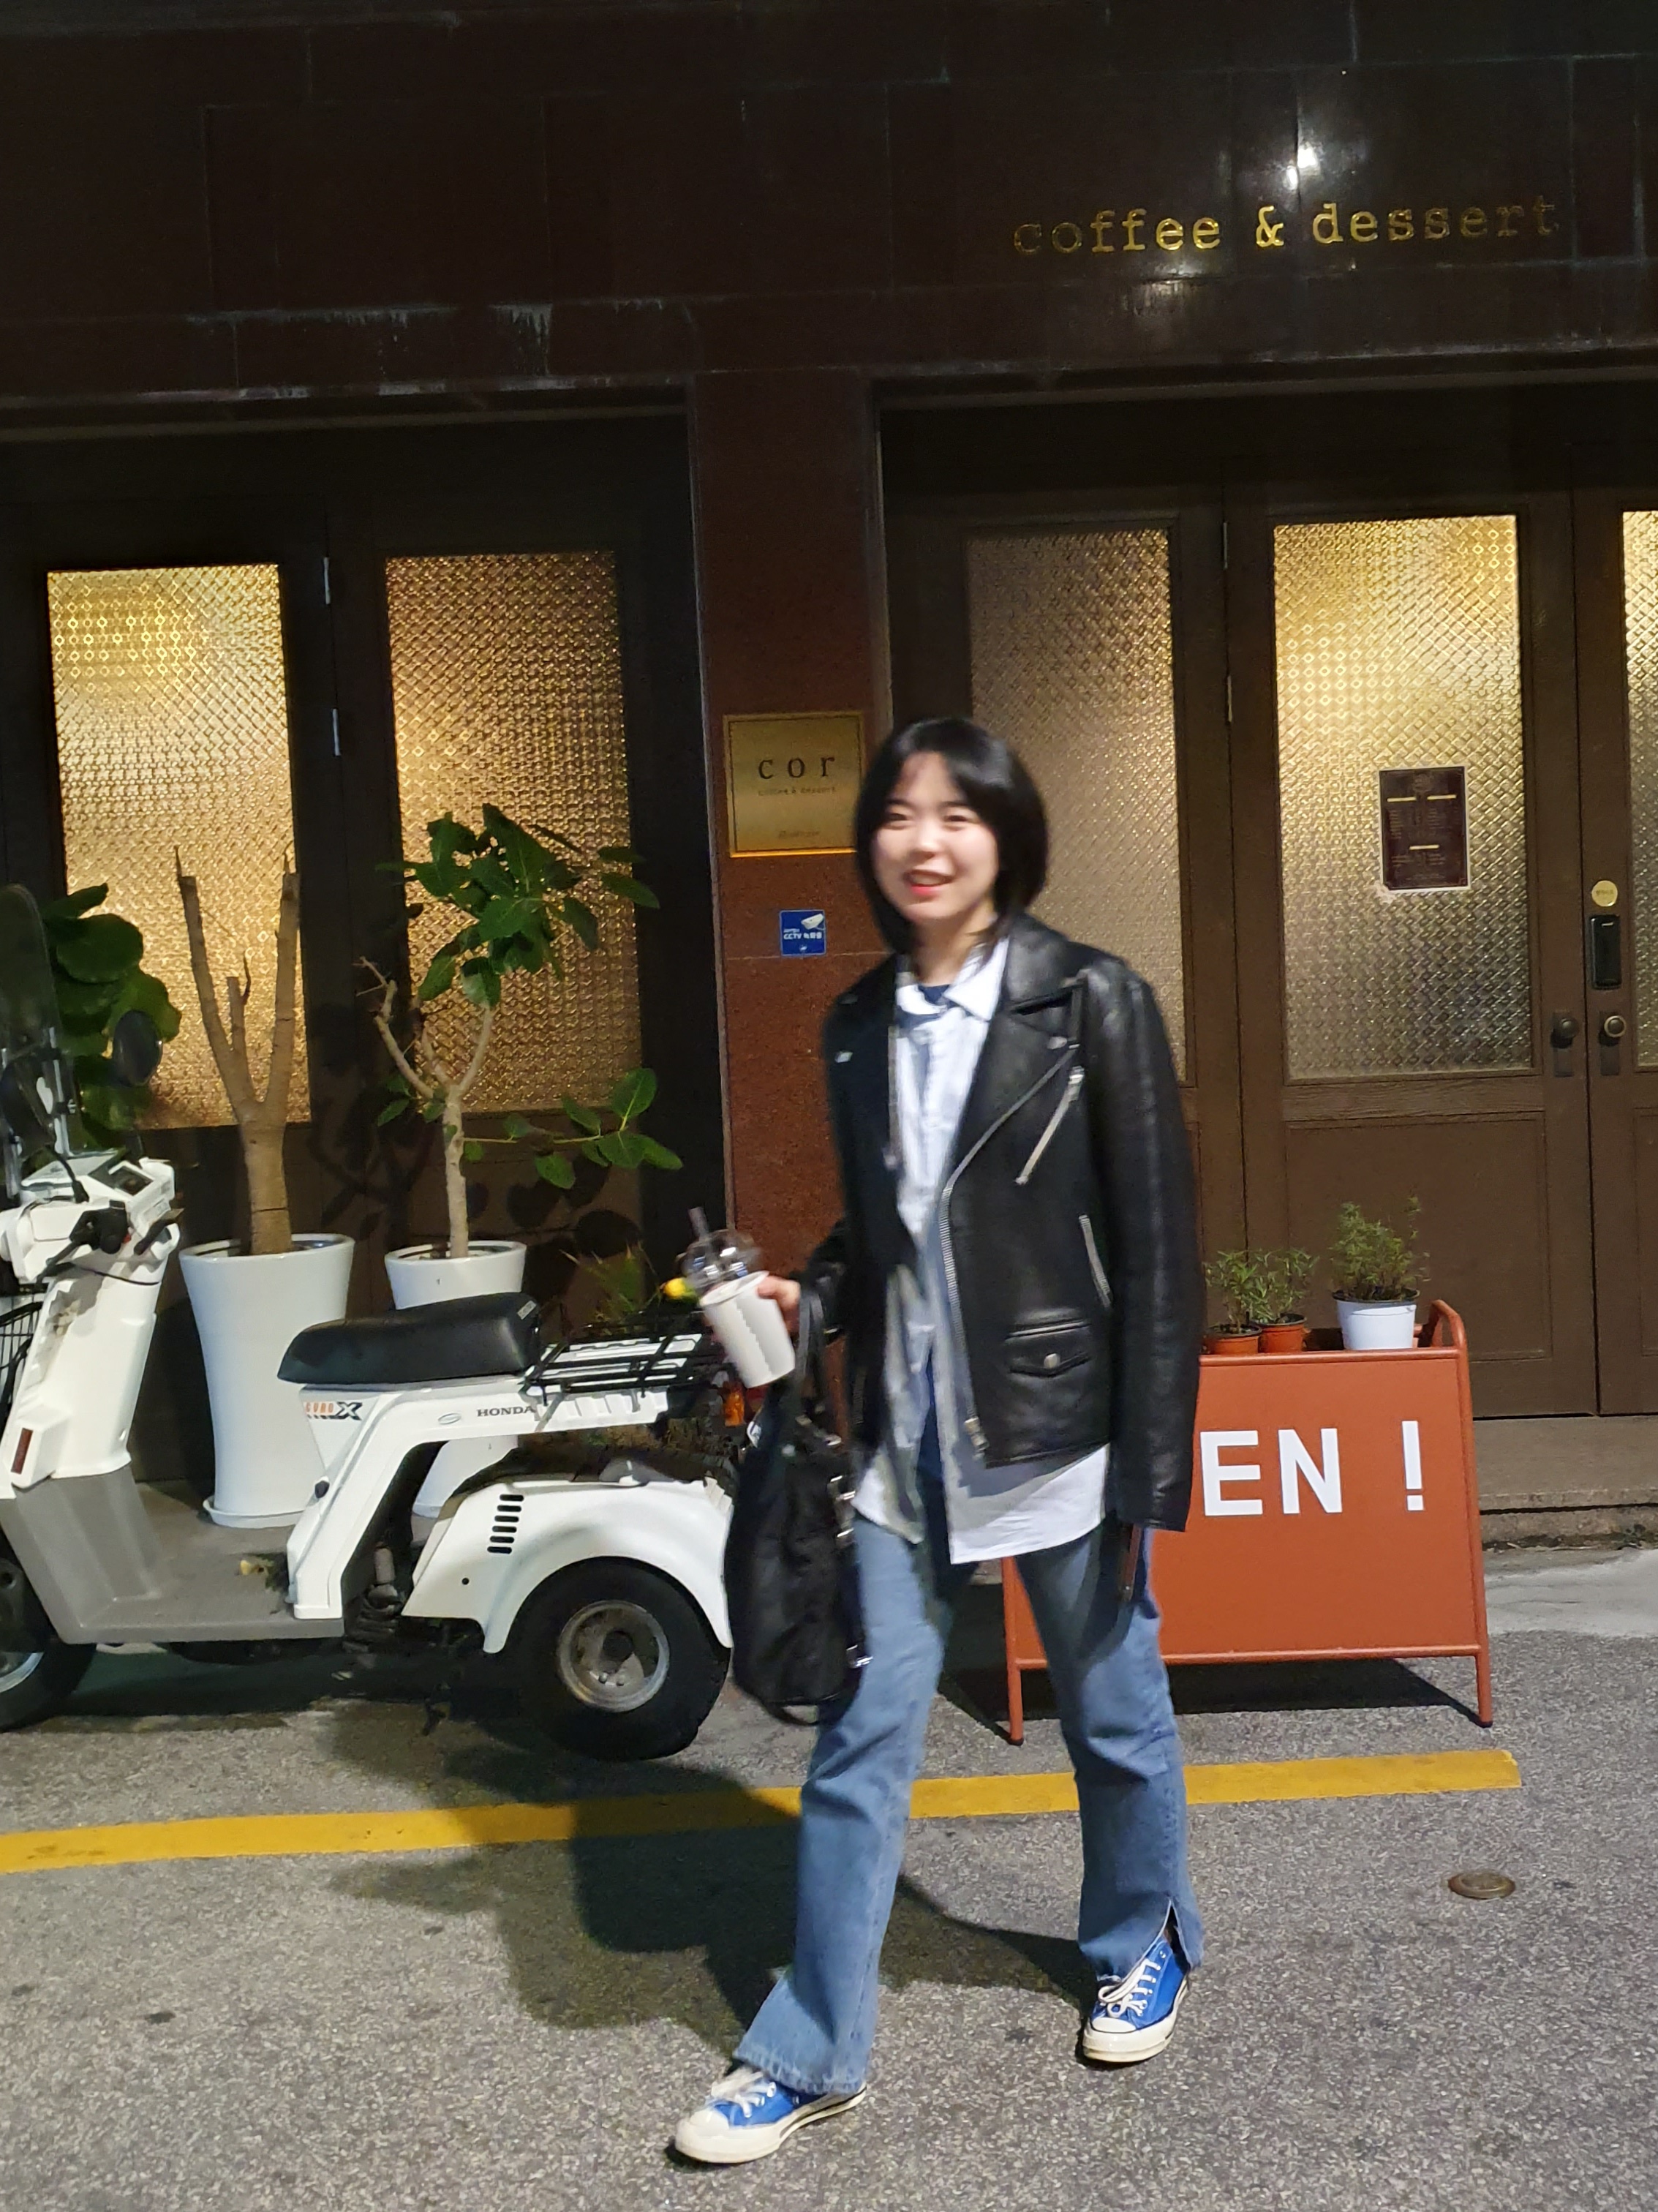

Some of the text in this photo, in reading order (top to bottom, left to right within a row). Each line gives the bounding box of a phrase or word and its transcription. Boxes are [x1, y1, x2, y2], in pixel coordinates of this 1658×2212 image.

[1014, 195, 1561, 256] coffee & dessert
[783, 933, 802, 941] CCTV
[476, 1406, 536, 1418] HONDA
[1199, 1427, 1343, 1516] EN
